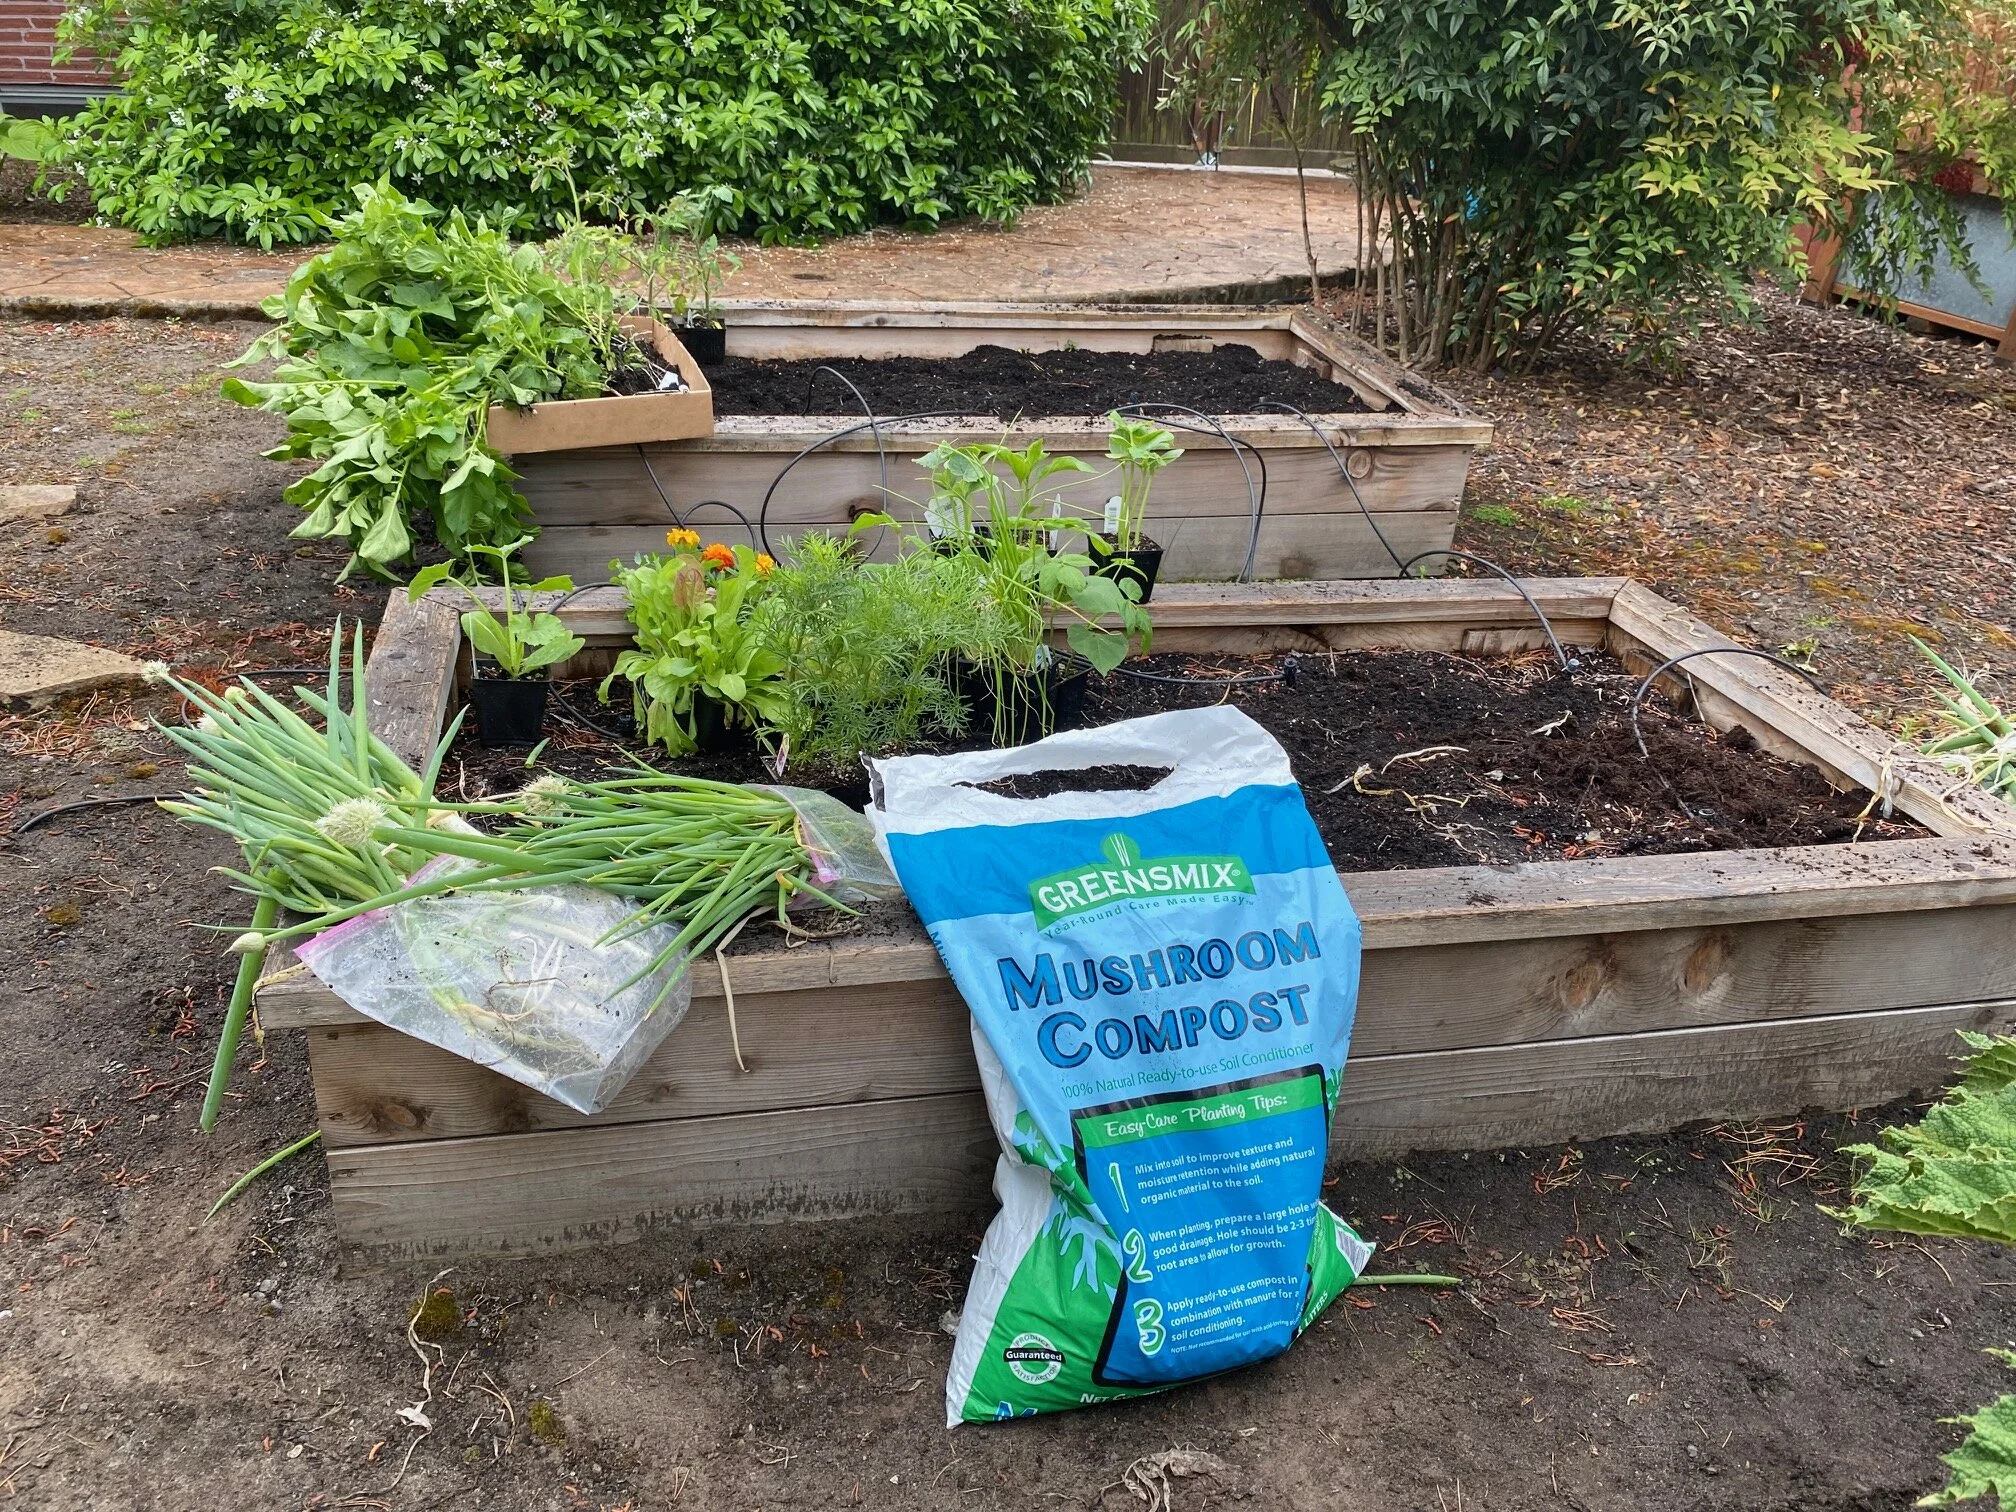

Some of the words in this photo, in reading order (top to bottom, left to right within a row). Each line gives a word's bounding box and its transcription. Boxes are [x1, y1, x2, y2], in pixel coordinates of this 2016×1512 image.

[1045, 905, 1122, 940] Year-Round
[1129, 900, 1160, 911] Care
[1167, 895, 1206, 907] Made
[997, 921, 1321, 1011] MUSHROOM
[1037, 984, 1310, 1069] COMPOST
[1061, 1083, 1093, 1098] 100%
[1096, 1072, 1135, 1093] Natural
[1138, 1063, 1218, 1087] Ready-to-use
[1220, 1057, 1240, 1072] Soil
[1241, 1042, 1315, 1067] Conditioner
[1104, 1113, 1178, 1138] Easy-Care
[1182, 1104, 1246, 1123] Planting
[1247, 1094, 1288, 1113] Tips:
[1135, 1163, 1153, 1175] Mix
[1155, 1160, 1171, 1171] into
[1171, 1155, 1185, 1168] soil
[1186, 1154, 1198, 1164] to
[1199, 1149, 1240, 1164] improve
[1241, 1144, 1273, 1157] texture
[1274, 1137, 1294, 1150] and
[1137, 1174, 1178, 1190] moisture
[1178, 1166, 1220, 1181] retention
[1221, 1163, 1249, 1175] while
[1250, 1156, 1281, 1171] adding
[1282, 1146, 1316, 1163] natural
[1108, 1162, 1129, 1214] 1
[1140, 1189, 1177, 1205] organic
[1178, 1181, 1210, 1196] material
[1211, 1180, 1223, 1189] to
[1224, 1178, 1242, 1188] the
[1243, 1175, 1263, 1187] soil.
[1149, 1230, 1177, 1243] When
[1179, 1222, 1213, 1238] planting,
[1214, 1214, 1253, 1229] prepare
[1255, 1213, 1262, 1222] a
[1263, 1207, 1287, 1223] large
[1288, 1203, 1310, 1215] hole
[1153, 1244, 1178, 1260] good
[1179, 1235, 1216, 1253] drainage.
[1217, 1230, 1239, 1242] Hole
[1240, 1223, 1275, 1236] should
[1276, 1222, 1289, 1234] be
[1290, 1219, 1305, 1231] 2-3
[1122, 1227, 1153, 1284] 2
[1156, 1260, 1177, 1273] root
[1179, 1257, 1199, 1268] area
[1199, 1254, 1207, 1263] to
[1207, 1248, 1229, 1261] allow
[1230, 1243, 1244, 1253] for
[1246, 1238, 1286, 1253] growth.
[1167, 1297, 1194, 1314] Apply
[1195, 1283, 1245, 1306] ready-to-use
[1247, 1276, 1287, 1292] compost
[1287, 1275, 1298, 1285] in
[1170, 1307, 1222, 1328] combination
[1222, 1301, 1244, 1313] with
[1244, 1293, 1277, 1309] manure
[1277, 1288, 1293, 1299] for
[1304, 1290, 1329, 1328] LITERS
[1133, 1297, 1166, 1356] 3
[1170, 1346, 1188, 1354] NOTE:
[1198, 1334, 1235, 1348] recommended
[1251, 1327, 1263, 1335] with
[1171, 1329, 1188, 1343] soil
[1189, 1316, 1246, 1338] conditioning.
[1006, 1350, 1062, 1361] Guaranteed
[1012, 1363, 1058, 1382] SATISFACTION
